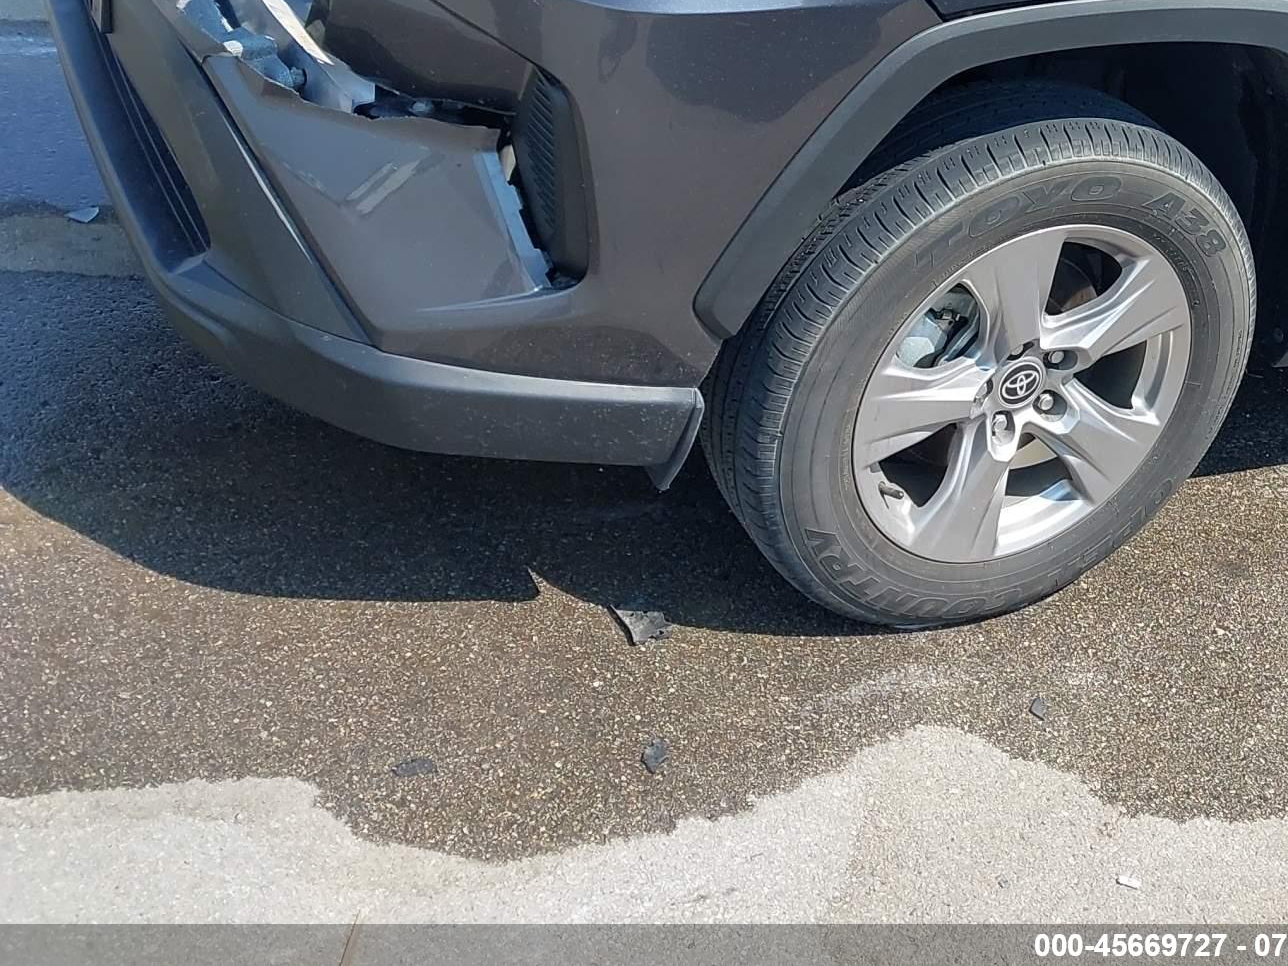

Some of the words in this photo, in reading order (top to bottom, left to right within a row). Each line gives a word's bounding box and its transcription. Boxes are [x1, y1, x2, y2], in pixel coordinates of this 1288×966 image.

[912, 175, 1123, 269] TOYO
[1142, 192, 1227, 258] A38
[804, 528, 1022, 620] COUNTRY
